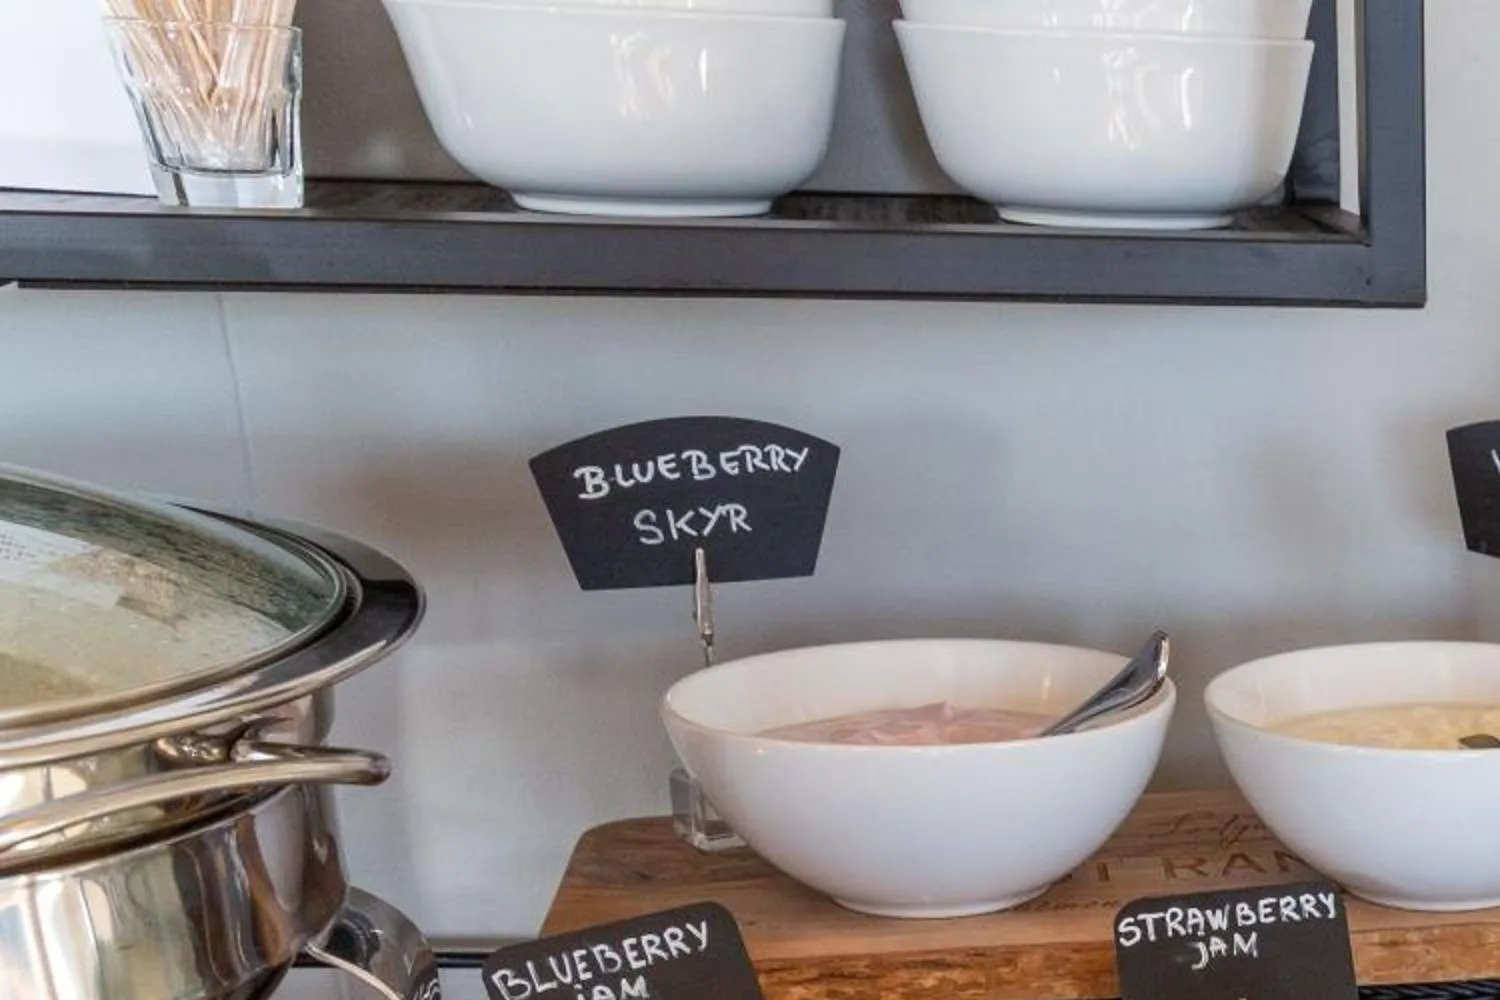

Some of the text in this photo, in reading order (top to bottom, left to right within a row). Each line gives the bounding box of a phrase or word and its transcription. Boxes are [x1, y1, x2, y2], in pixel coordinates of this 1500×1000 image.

[573, 443, 809, 500] BLUEBERRY
[633, 503, 752, 545] SKYR
[1117, 892, 1336, 947] STRAWBERRY
